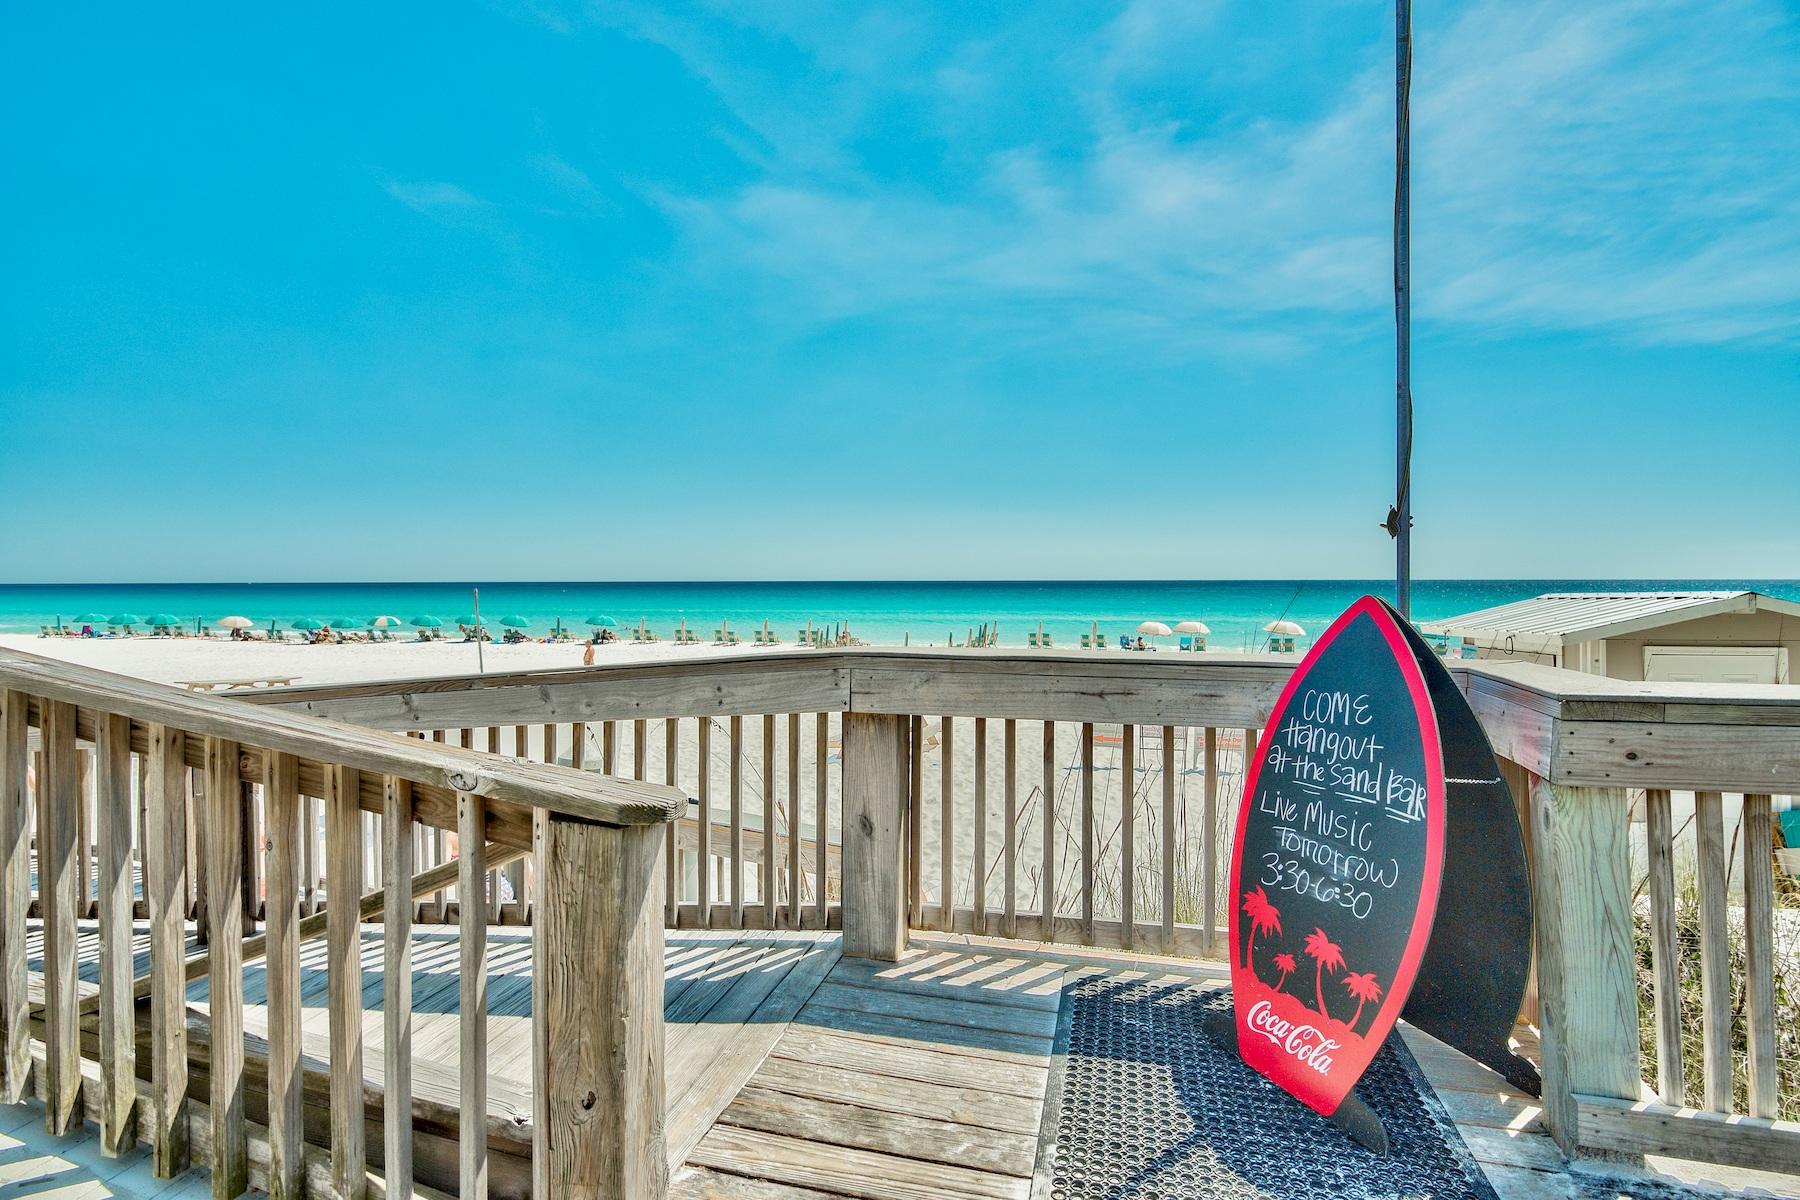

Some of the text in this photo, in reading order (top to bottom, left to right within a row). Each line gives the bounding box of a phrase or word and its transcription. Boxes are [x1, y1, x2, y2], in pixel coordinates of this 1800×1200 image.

[1268, 745, 1292, 773] at
[1291, 755, 1325, 782] the
[1261, 853, 1372, 918] 3:30-6:30
